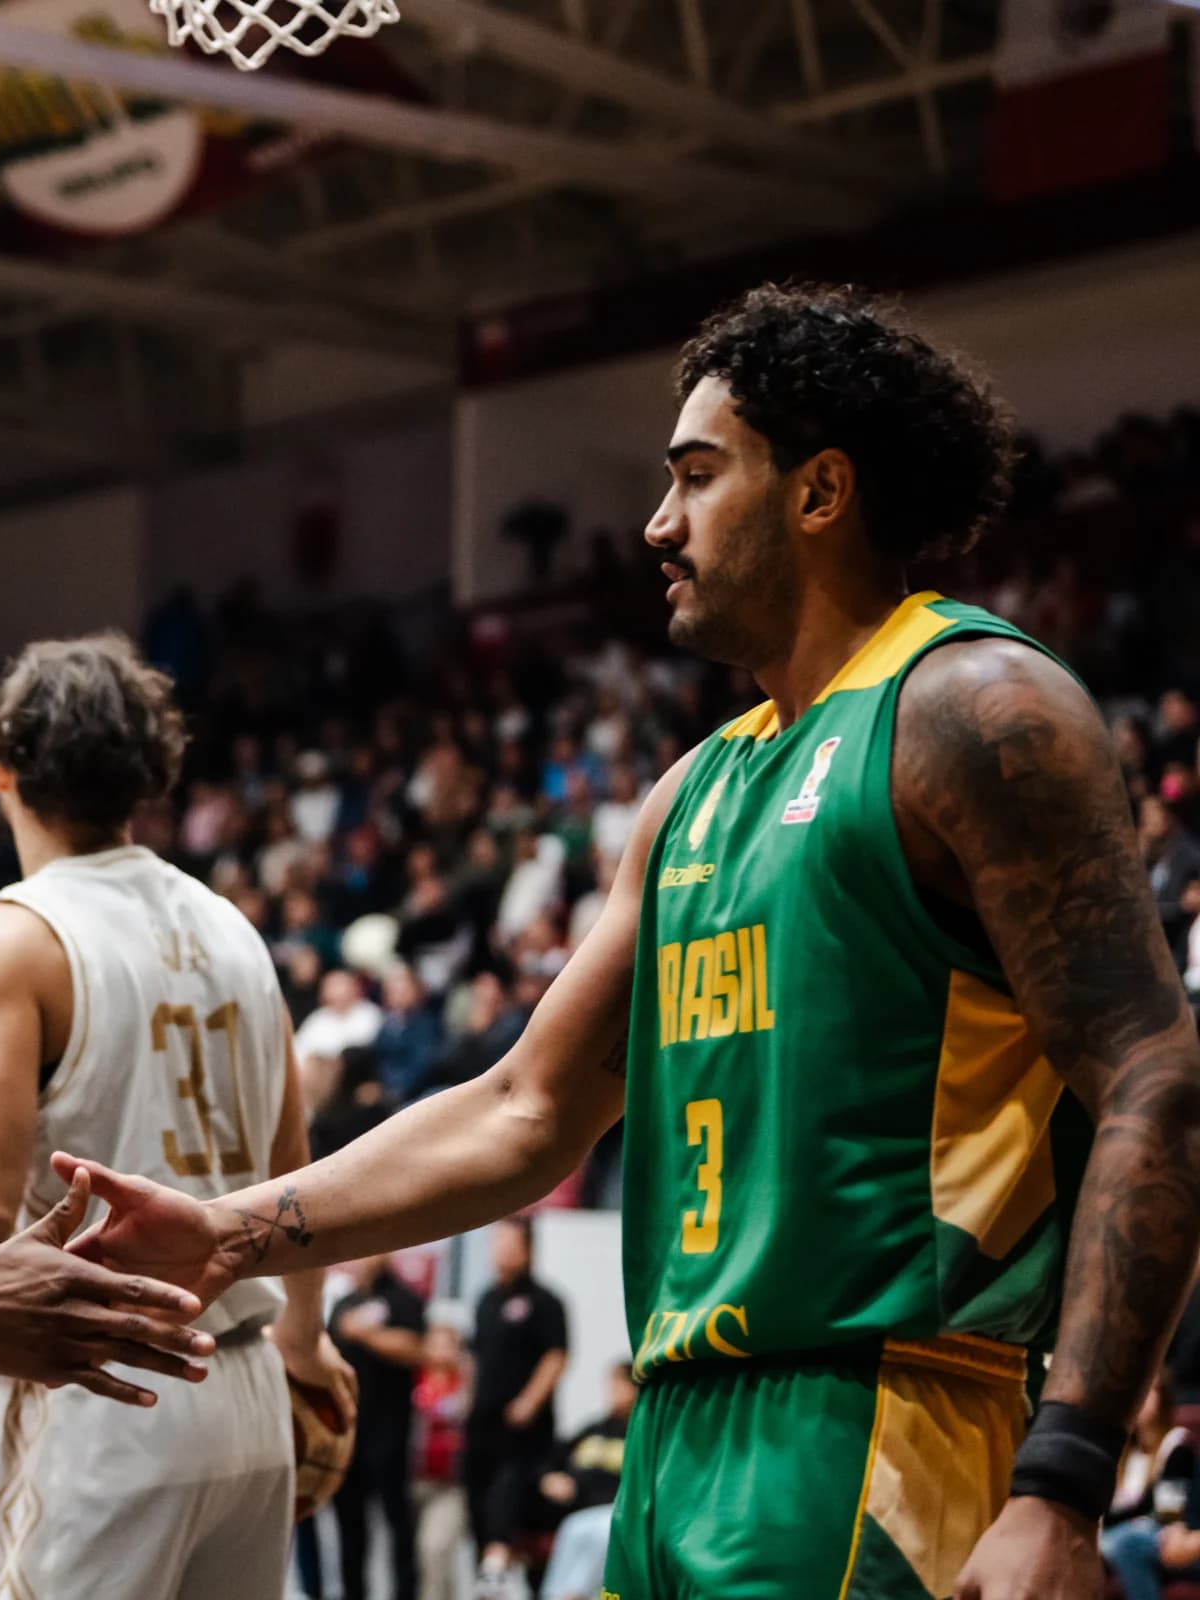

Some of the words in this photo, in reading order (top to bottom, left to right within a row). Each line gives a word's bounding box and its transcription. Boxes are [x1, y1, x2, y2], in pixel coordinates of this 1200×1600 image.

[657, 923, 776, 1050] RASIL
[150, 1001, 256, 1178] 31
[683, 1098, 723, 1254] 3
